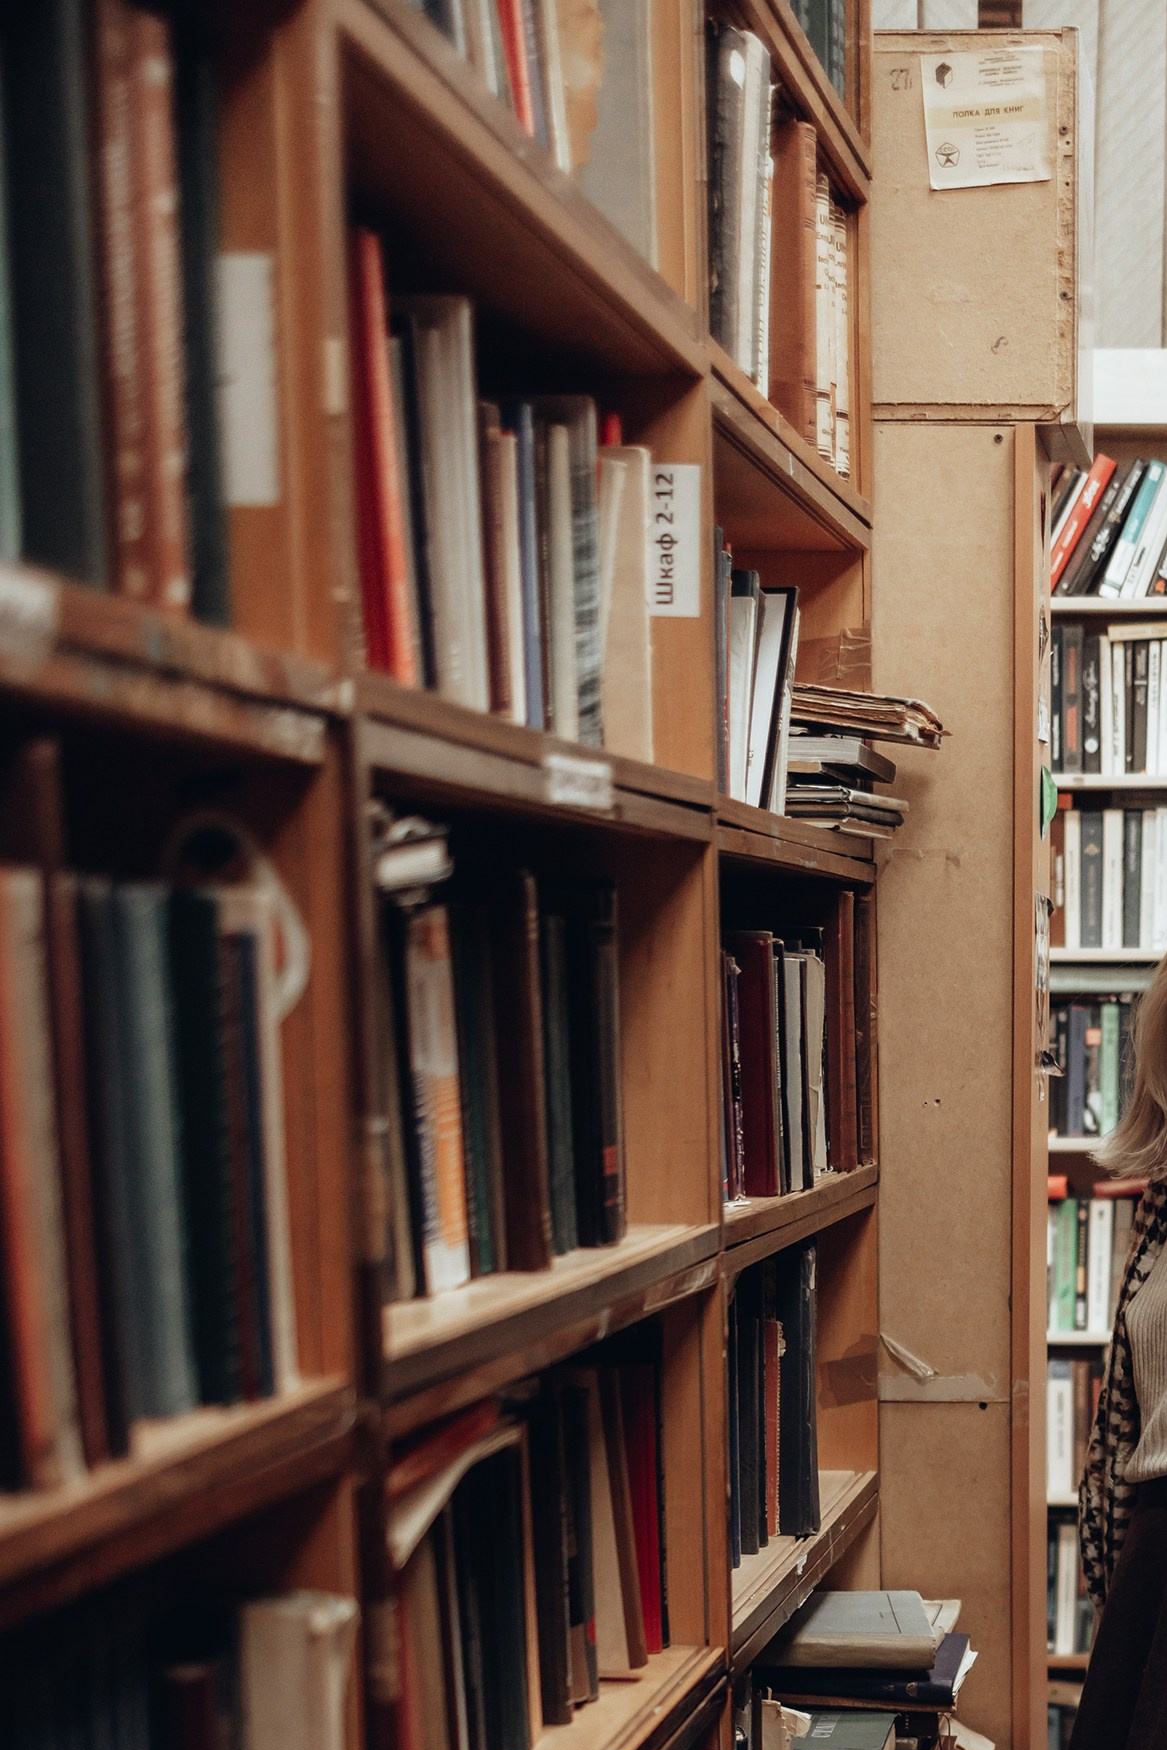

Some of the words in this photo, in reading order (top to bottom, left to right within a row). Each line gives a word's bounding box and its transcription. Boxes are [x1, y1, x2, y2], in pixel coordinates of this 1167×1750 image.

[952, 109, 981, 119] ПОЛКА
[984, 107, 1000, 117] ДЛЯ
[1003, 104, 1025, 115] КНИГ
[655, 473, 674, 525] 2-12
[655, 533, 678, 605] Шкаф
